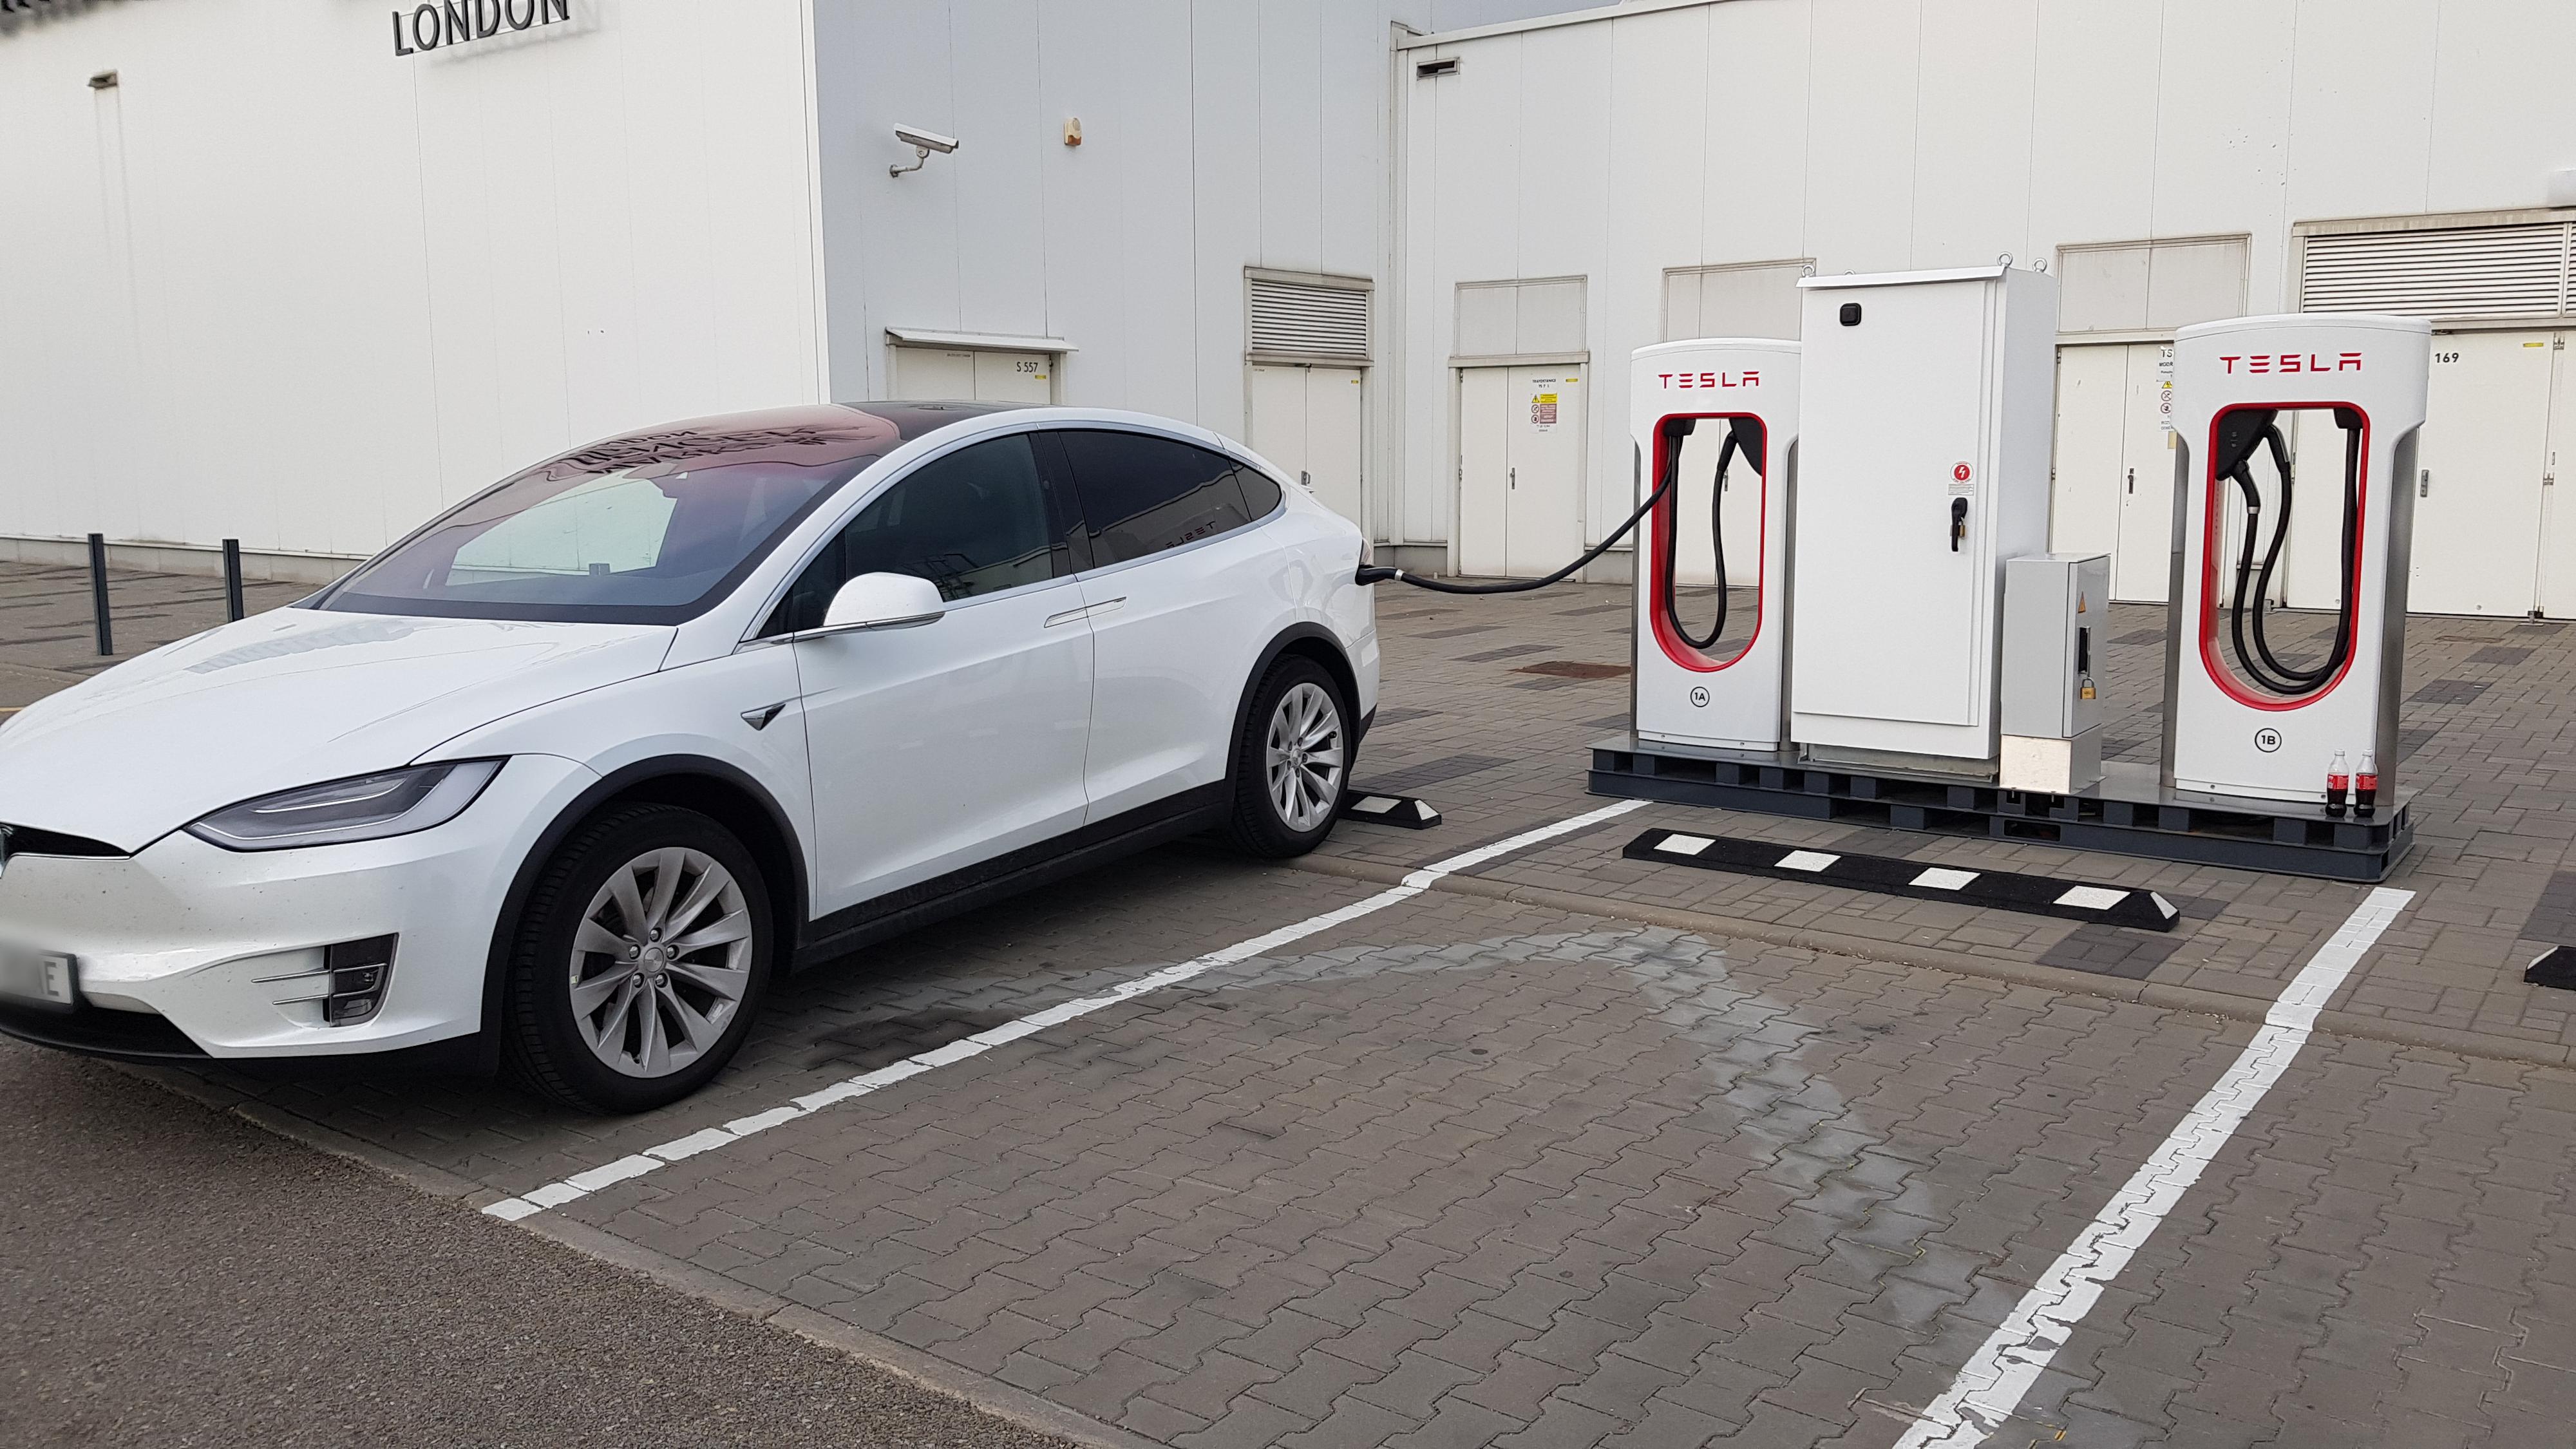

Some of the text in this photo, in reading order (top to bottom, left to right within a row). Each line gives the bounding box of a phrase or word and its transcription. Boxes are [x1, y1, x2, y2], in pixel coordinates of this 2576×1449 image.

[392, 0, 571, 56] LONDON
[2219, 352, 2362, 374] TESLA
[2435, 352, 2459, 363] 169
[1016, 361, 1038, 372] S 557
[1658, 371, 1760, 389] TESLA
[1694, 692, 1706, 701] 1A
[2261, 735, 2276, 745] 1B
